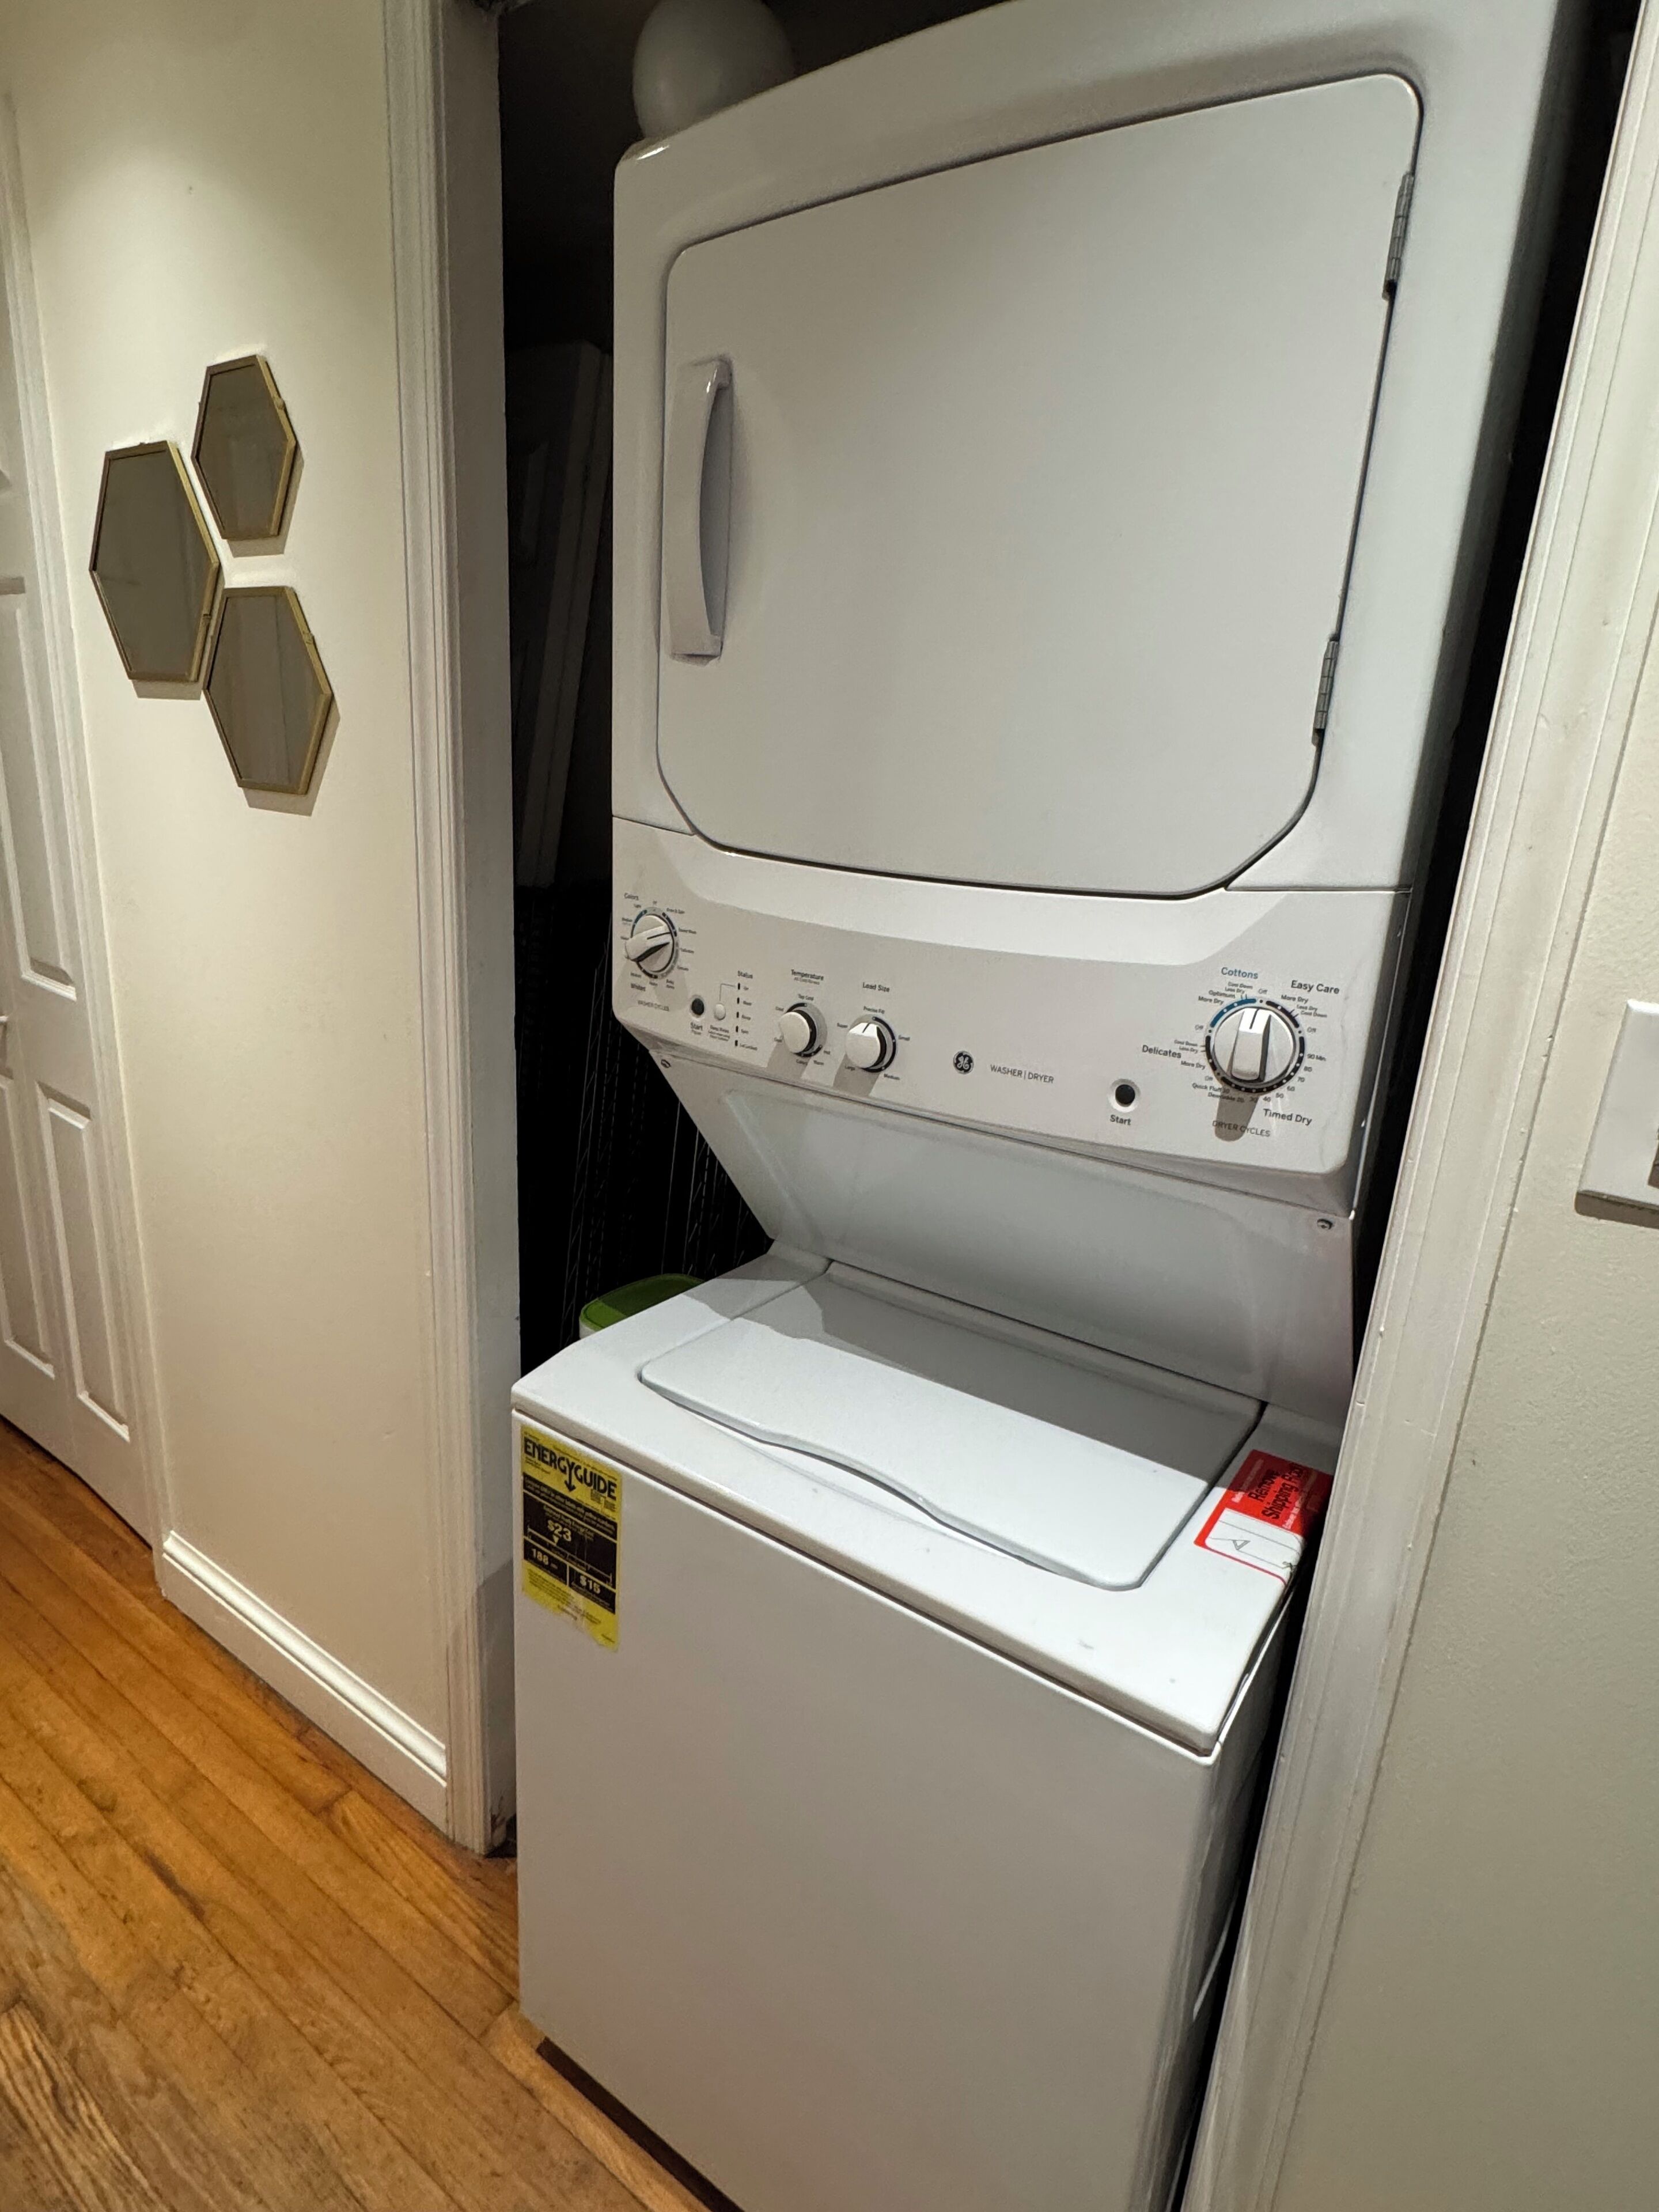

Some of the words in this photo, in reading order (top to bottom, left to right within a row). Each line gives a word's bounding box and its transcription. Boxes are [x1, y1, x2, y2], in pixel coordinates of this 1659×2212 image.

[791, 969, 824, 981] Temperature
[1221, 967, 1258, 980] Cottons
[863, 982, 876, 990] Load
[1291, 980, 1314, 993] Easy
[1316, 983, 1340, 995] Care
[1198, 995, 1213, 1003] More
[1142, 1044, 1181, 1059] Delicates
[990, 1064, 1022, 1078] WASHER
[1028, 1071, 1054, 1084] DRYER
[1110, 1114, 1132, 1126] Start
[1263, 1108, 1293, 1122] Timed
[1295, 1114, 1312, 1126] Dry
[1213, 1120, 1238, 1131] DRYER
[1240, 1125, 1271, 1137] CYCLES
[524, 1436, 618, 1501] ENERGYGUIDE
[1248, 1469, 1281, 1503] Remove
[1262, 1482, 1299, 1520] Shipping
[547, 1520, 572, 1542] $23
[580, 1574, 600, 1594] $15
